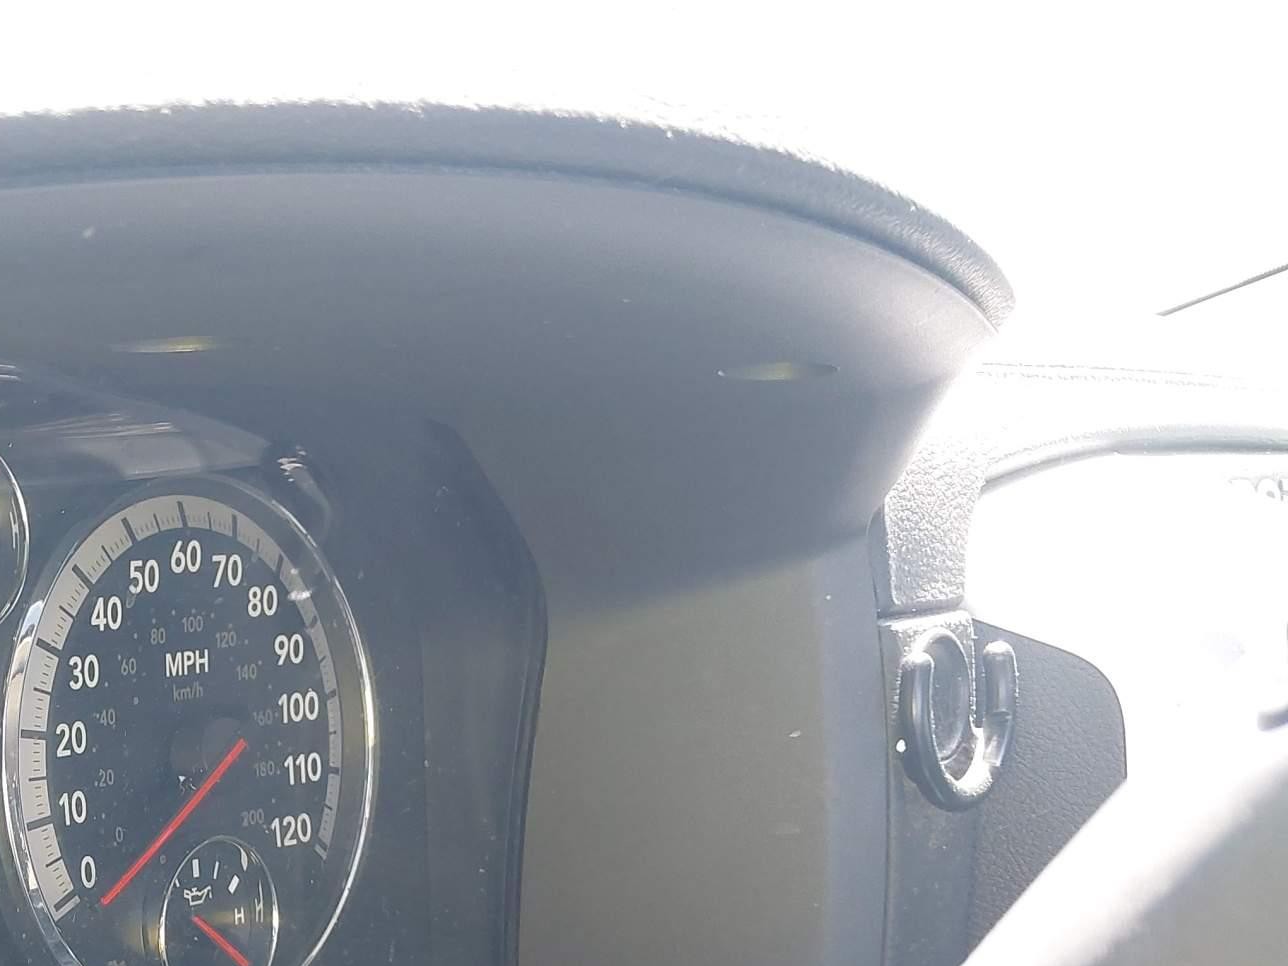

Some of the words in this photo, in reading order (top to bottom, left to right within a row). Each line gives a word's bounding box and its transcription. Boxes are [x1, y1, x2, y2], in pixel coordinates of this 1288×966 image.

[171, 540, 201, 573] 60
[212, 554, 243, 588] 70
[129, 559, 159, 593] 50
[91, 596, 122, 631] 40
[247, 585, 278, 618] 80
[150, 628, 166, 645] 80
[182, 616, 204, 633] 100
[215, 631, 237, 649] 120
[166, 649, 209, 677] MPH
[274, 634, 304, 666] 90
[68, 654, 99, 690] 30
[121, 658, 137, 676] 60
[236, 664, 257, 681] 140
[173, 681, 203, 701] km/h
[278, 690, 319, 723] 100
[99, 709, 116, 726] 40
[55, 720, 87, 757] 20
[99, 769, 114, 787] 20
[284, 752, 322, 785] 110
[59, 790, 87, 826] 10
[241, 809, 265, 827] 200
[271, 813, 311, 848] 120
[81, 856, 96, 889] 0
[234, 907, 245, 925] H
